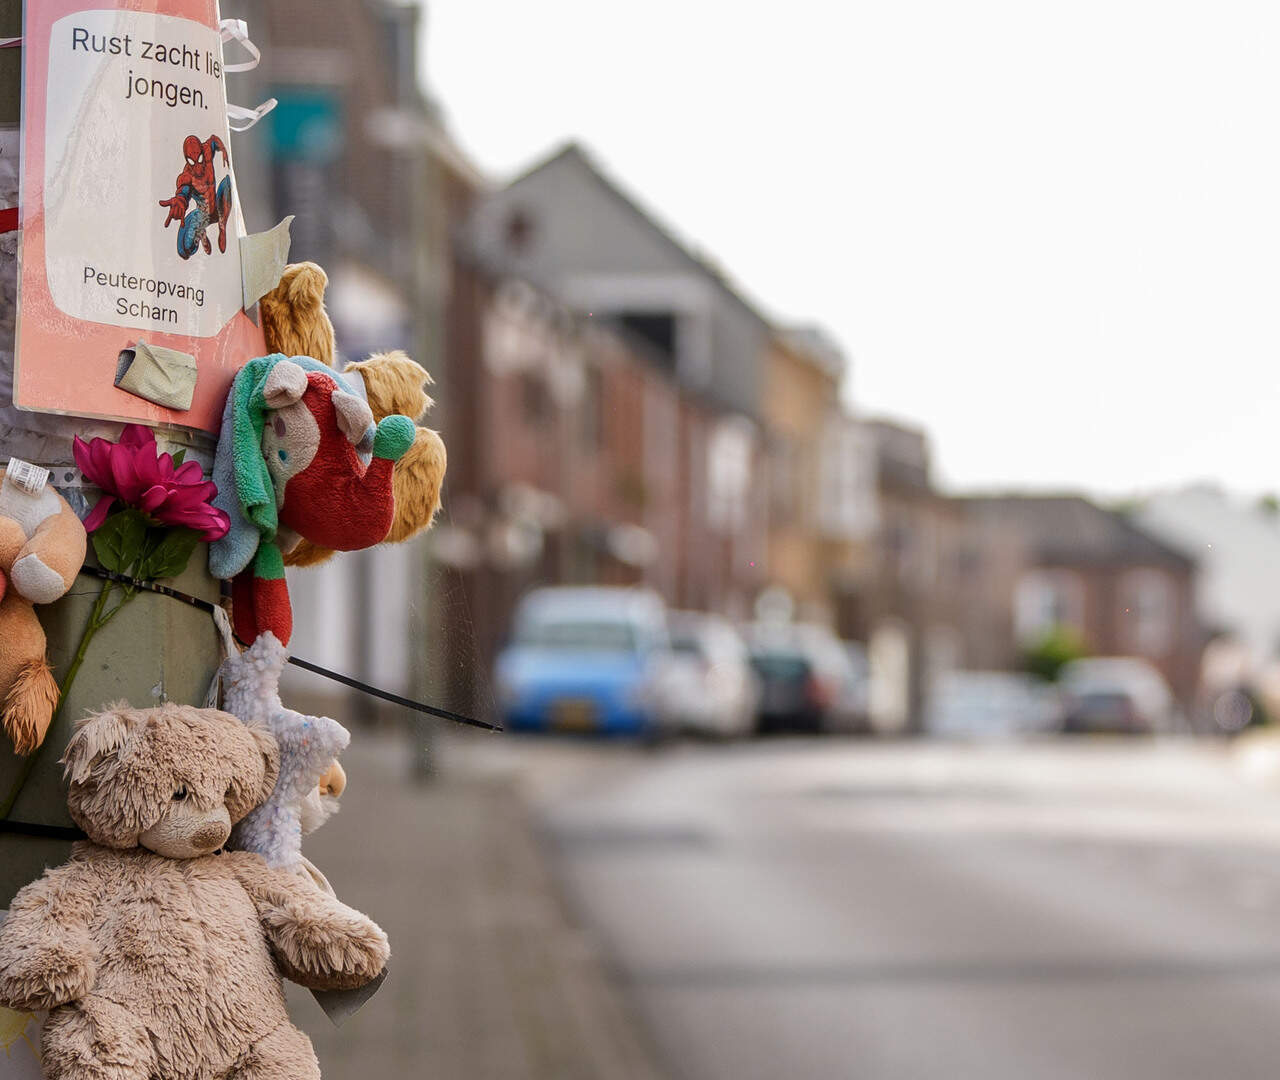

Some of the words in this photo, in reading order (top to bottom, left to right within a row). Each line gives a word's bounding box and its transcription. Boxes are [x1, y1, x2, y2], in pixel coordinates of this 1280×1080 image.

[72, 27, 132, 56] Rust
[141, 41, 201, 72] zacht
[205, 51, 222, 79] lie
[125, 70, 208, 110] jongen.
[83, 266, 205, 307] Peuteropvang
[116, 297, 178, 324] Scharn
